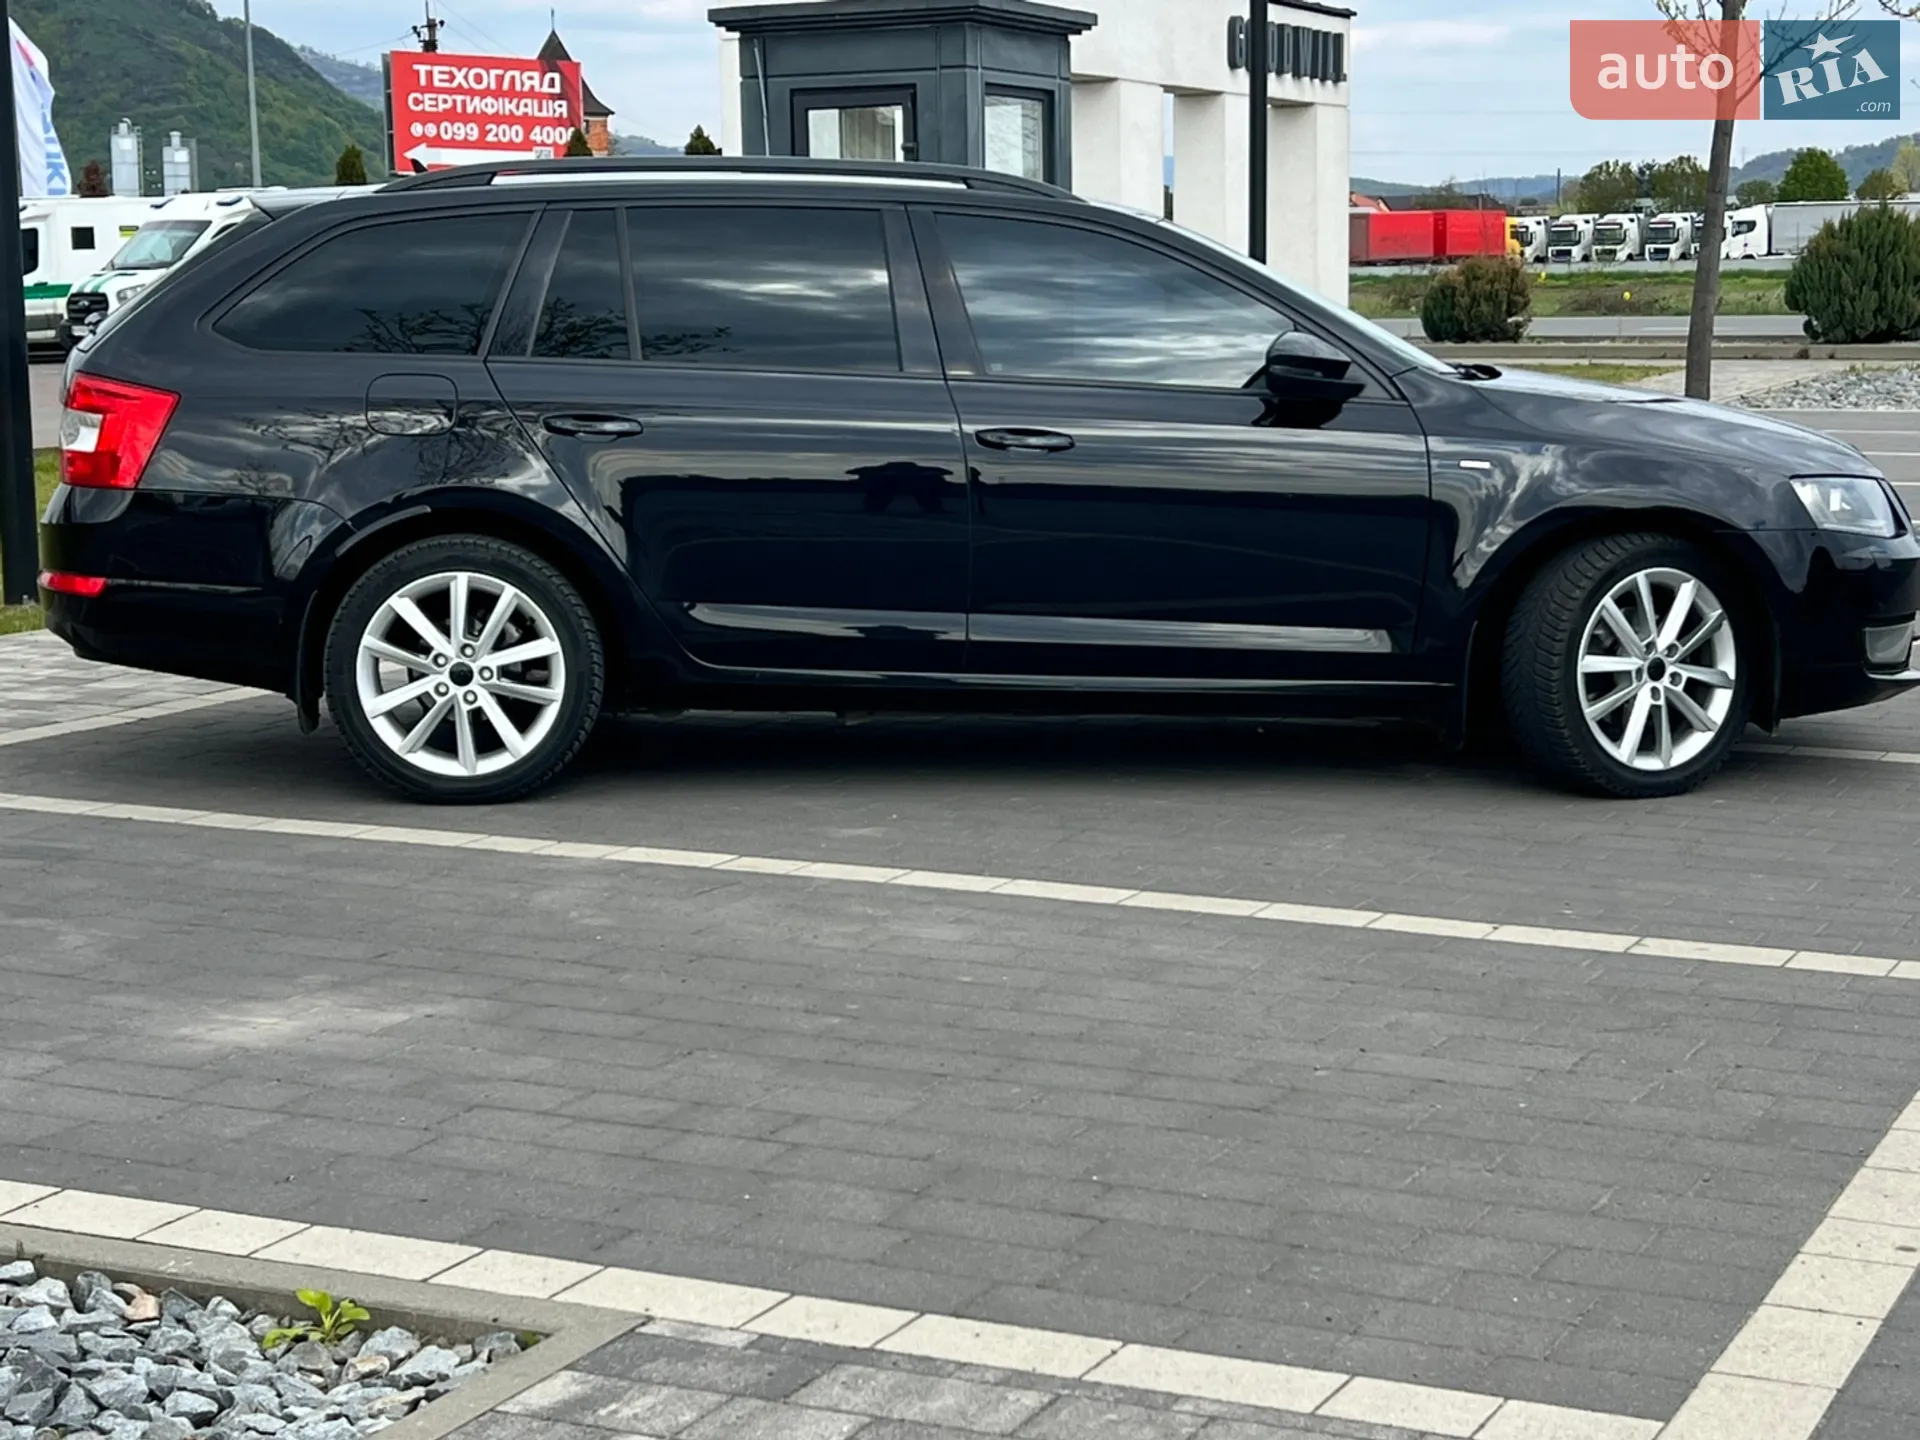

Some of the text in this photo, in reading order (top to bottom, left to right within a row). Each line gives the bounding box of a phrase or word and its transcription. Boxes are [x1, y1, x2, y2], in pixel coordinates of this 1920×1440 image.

[1227, 15, 1347, 83] GODWILL
[412, 64, 561, 94] ТЕХОГЛЯД
[407, 92, 568, 118] СЕРТИФІКАЦІЯ
[439, 121, 479, 141] 099
[485, 124, 524, 143] 200
